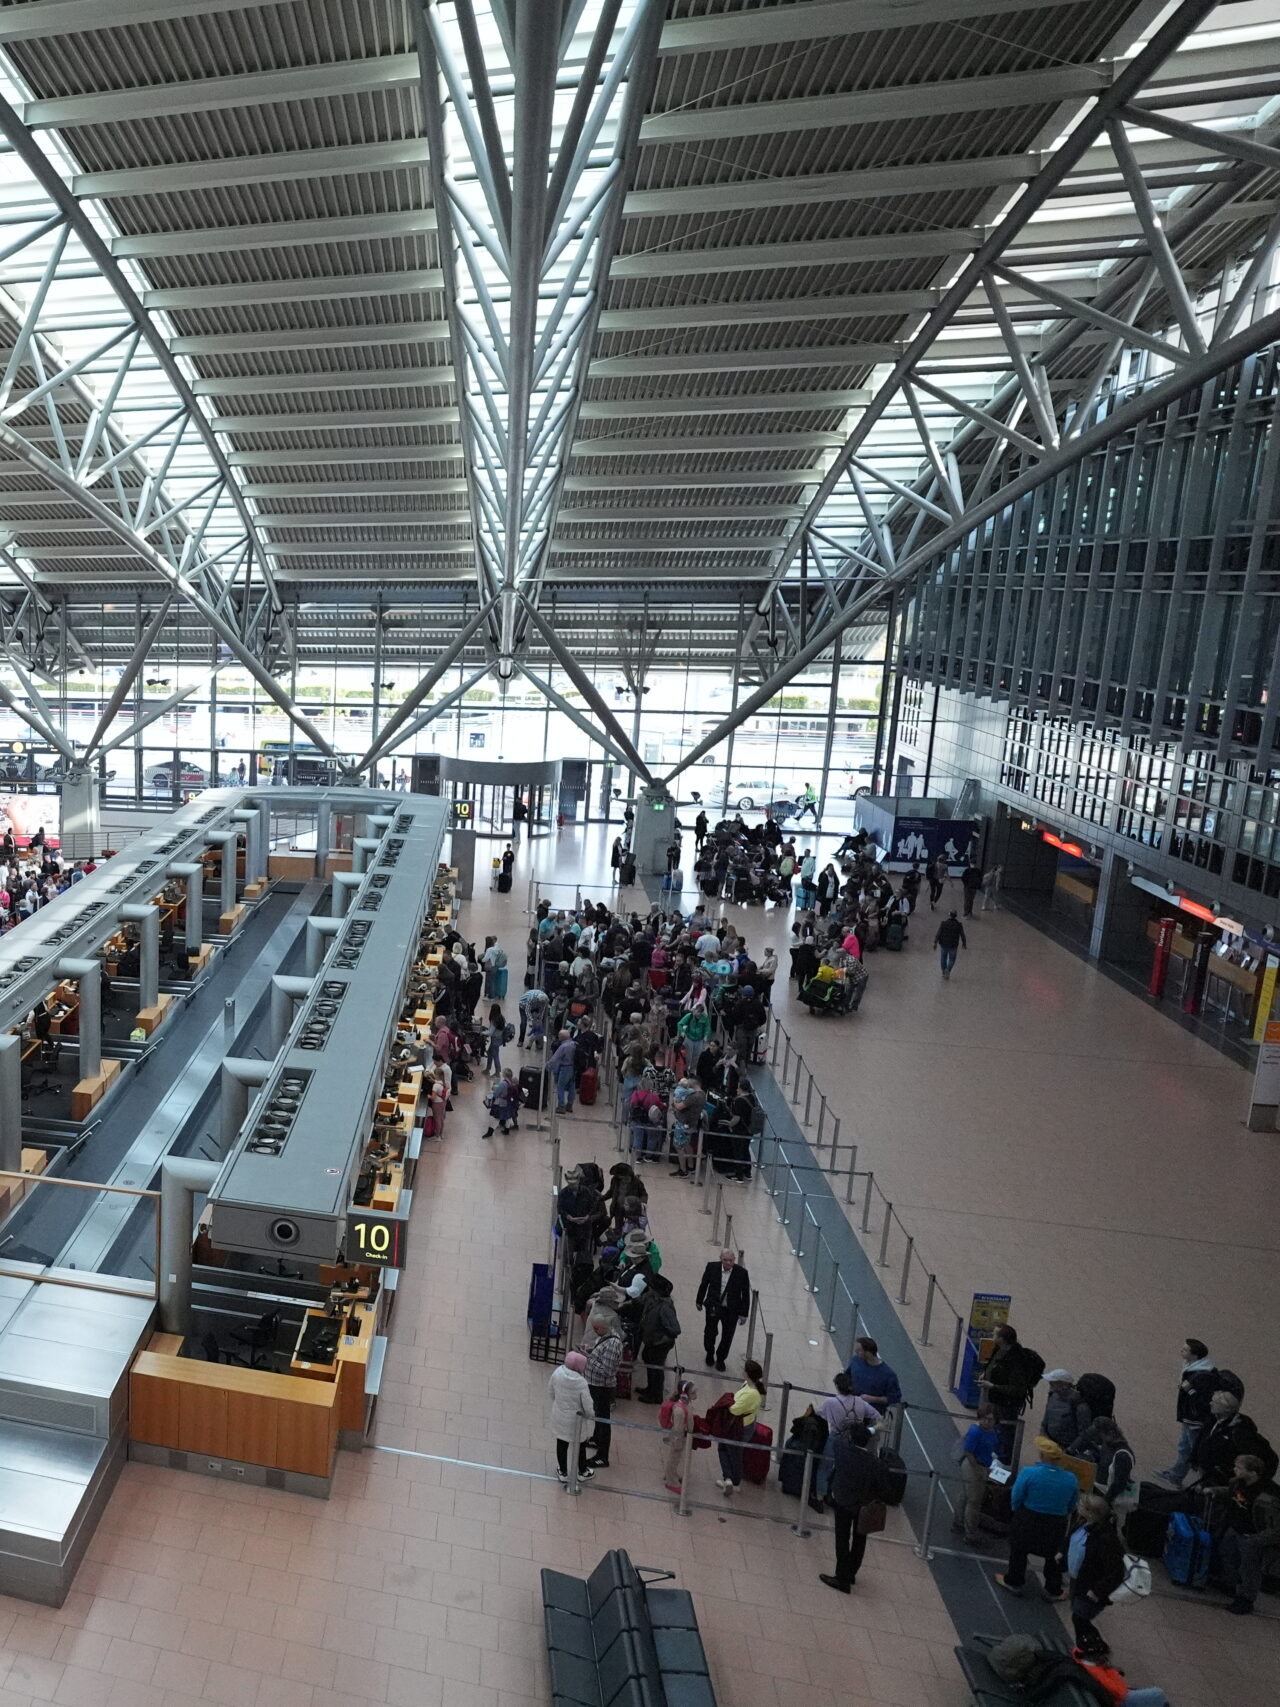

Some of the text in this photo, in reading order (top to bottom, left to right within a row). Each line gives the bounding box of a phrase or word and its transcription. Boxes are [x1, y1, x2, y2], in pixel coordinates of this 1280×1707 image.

[456, 803, 469, 814] 10
[354, 1223, 390, 1251] 10
[365, 1252, 388, 1260] Check-in
